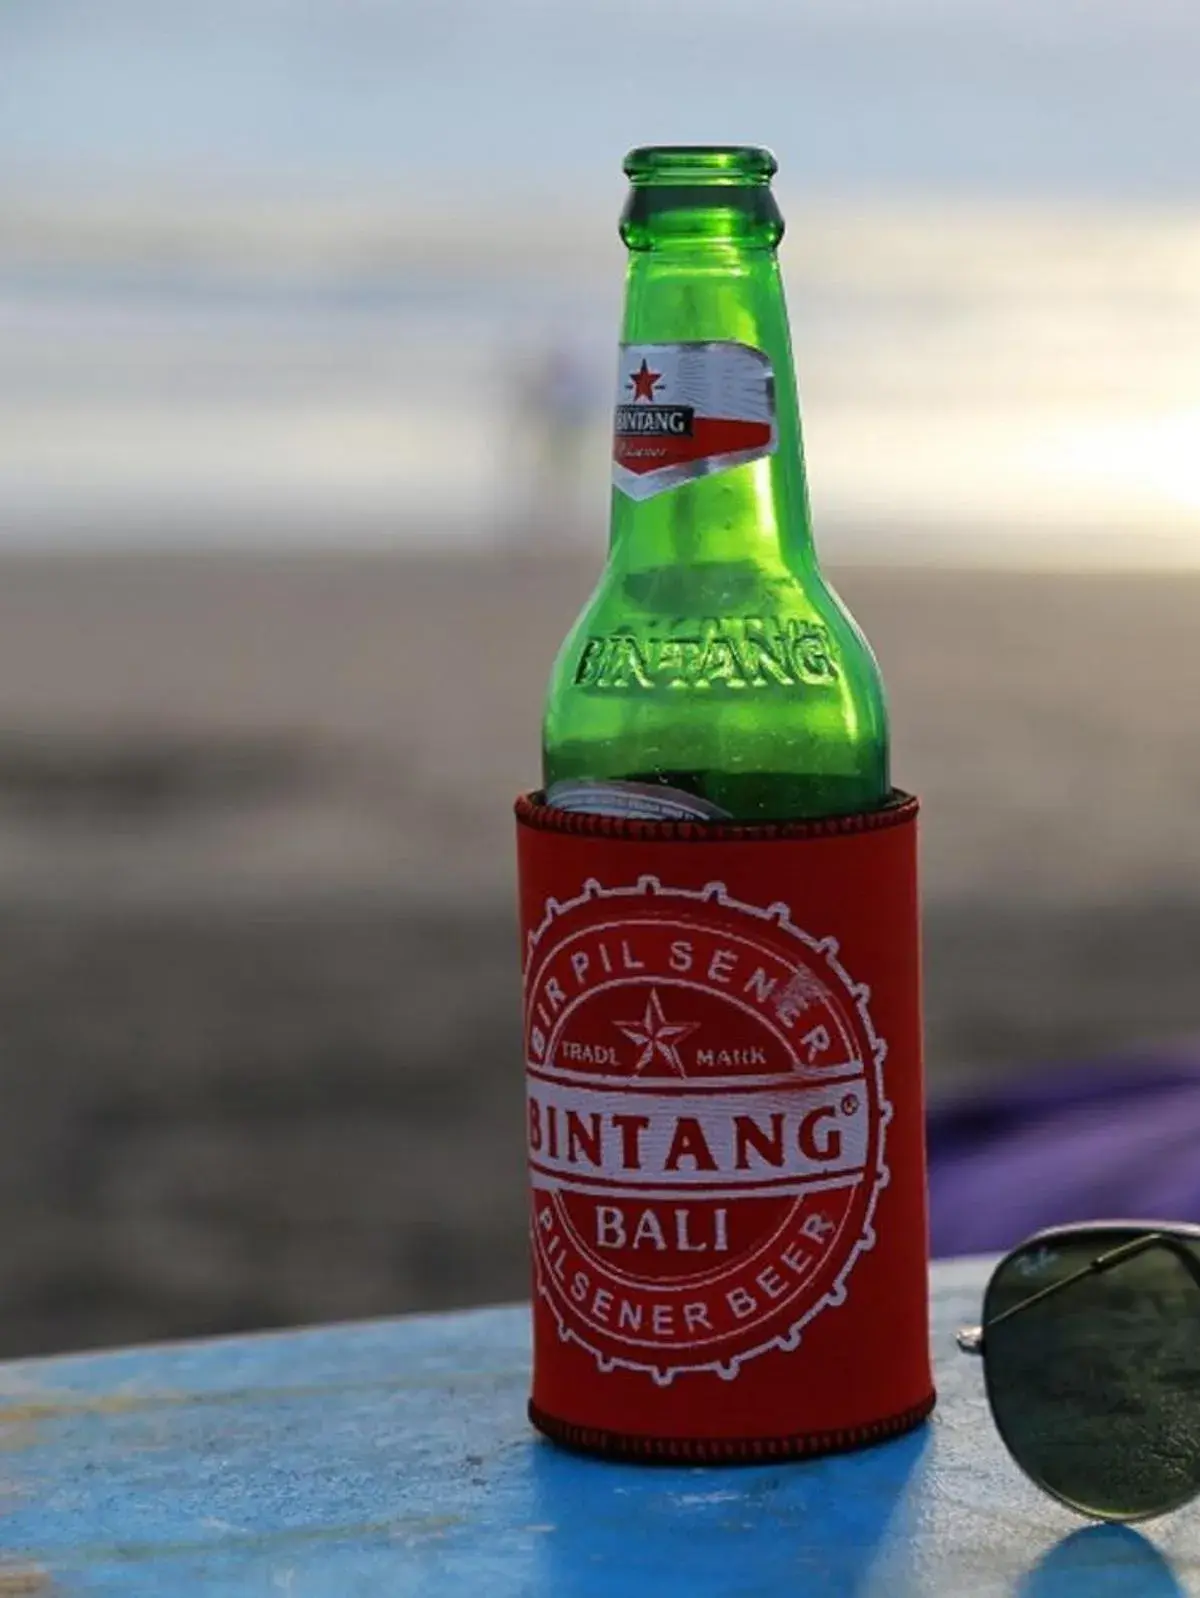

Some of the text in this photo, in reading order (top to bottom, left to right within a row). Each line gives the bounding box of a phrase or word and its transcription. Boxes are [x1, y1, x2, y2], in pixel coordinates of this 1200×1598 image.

[574, 634, 839, 688] BINTANG
[531, 976, 567, 1060] BIR
[595, 1206, 728, 1250] BALI
[540, 1207, 837, 1336] PILSENER BEER
